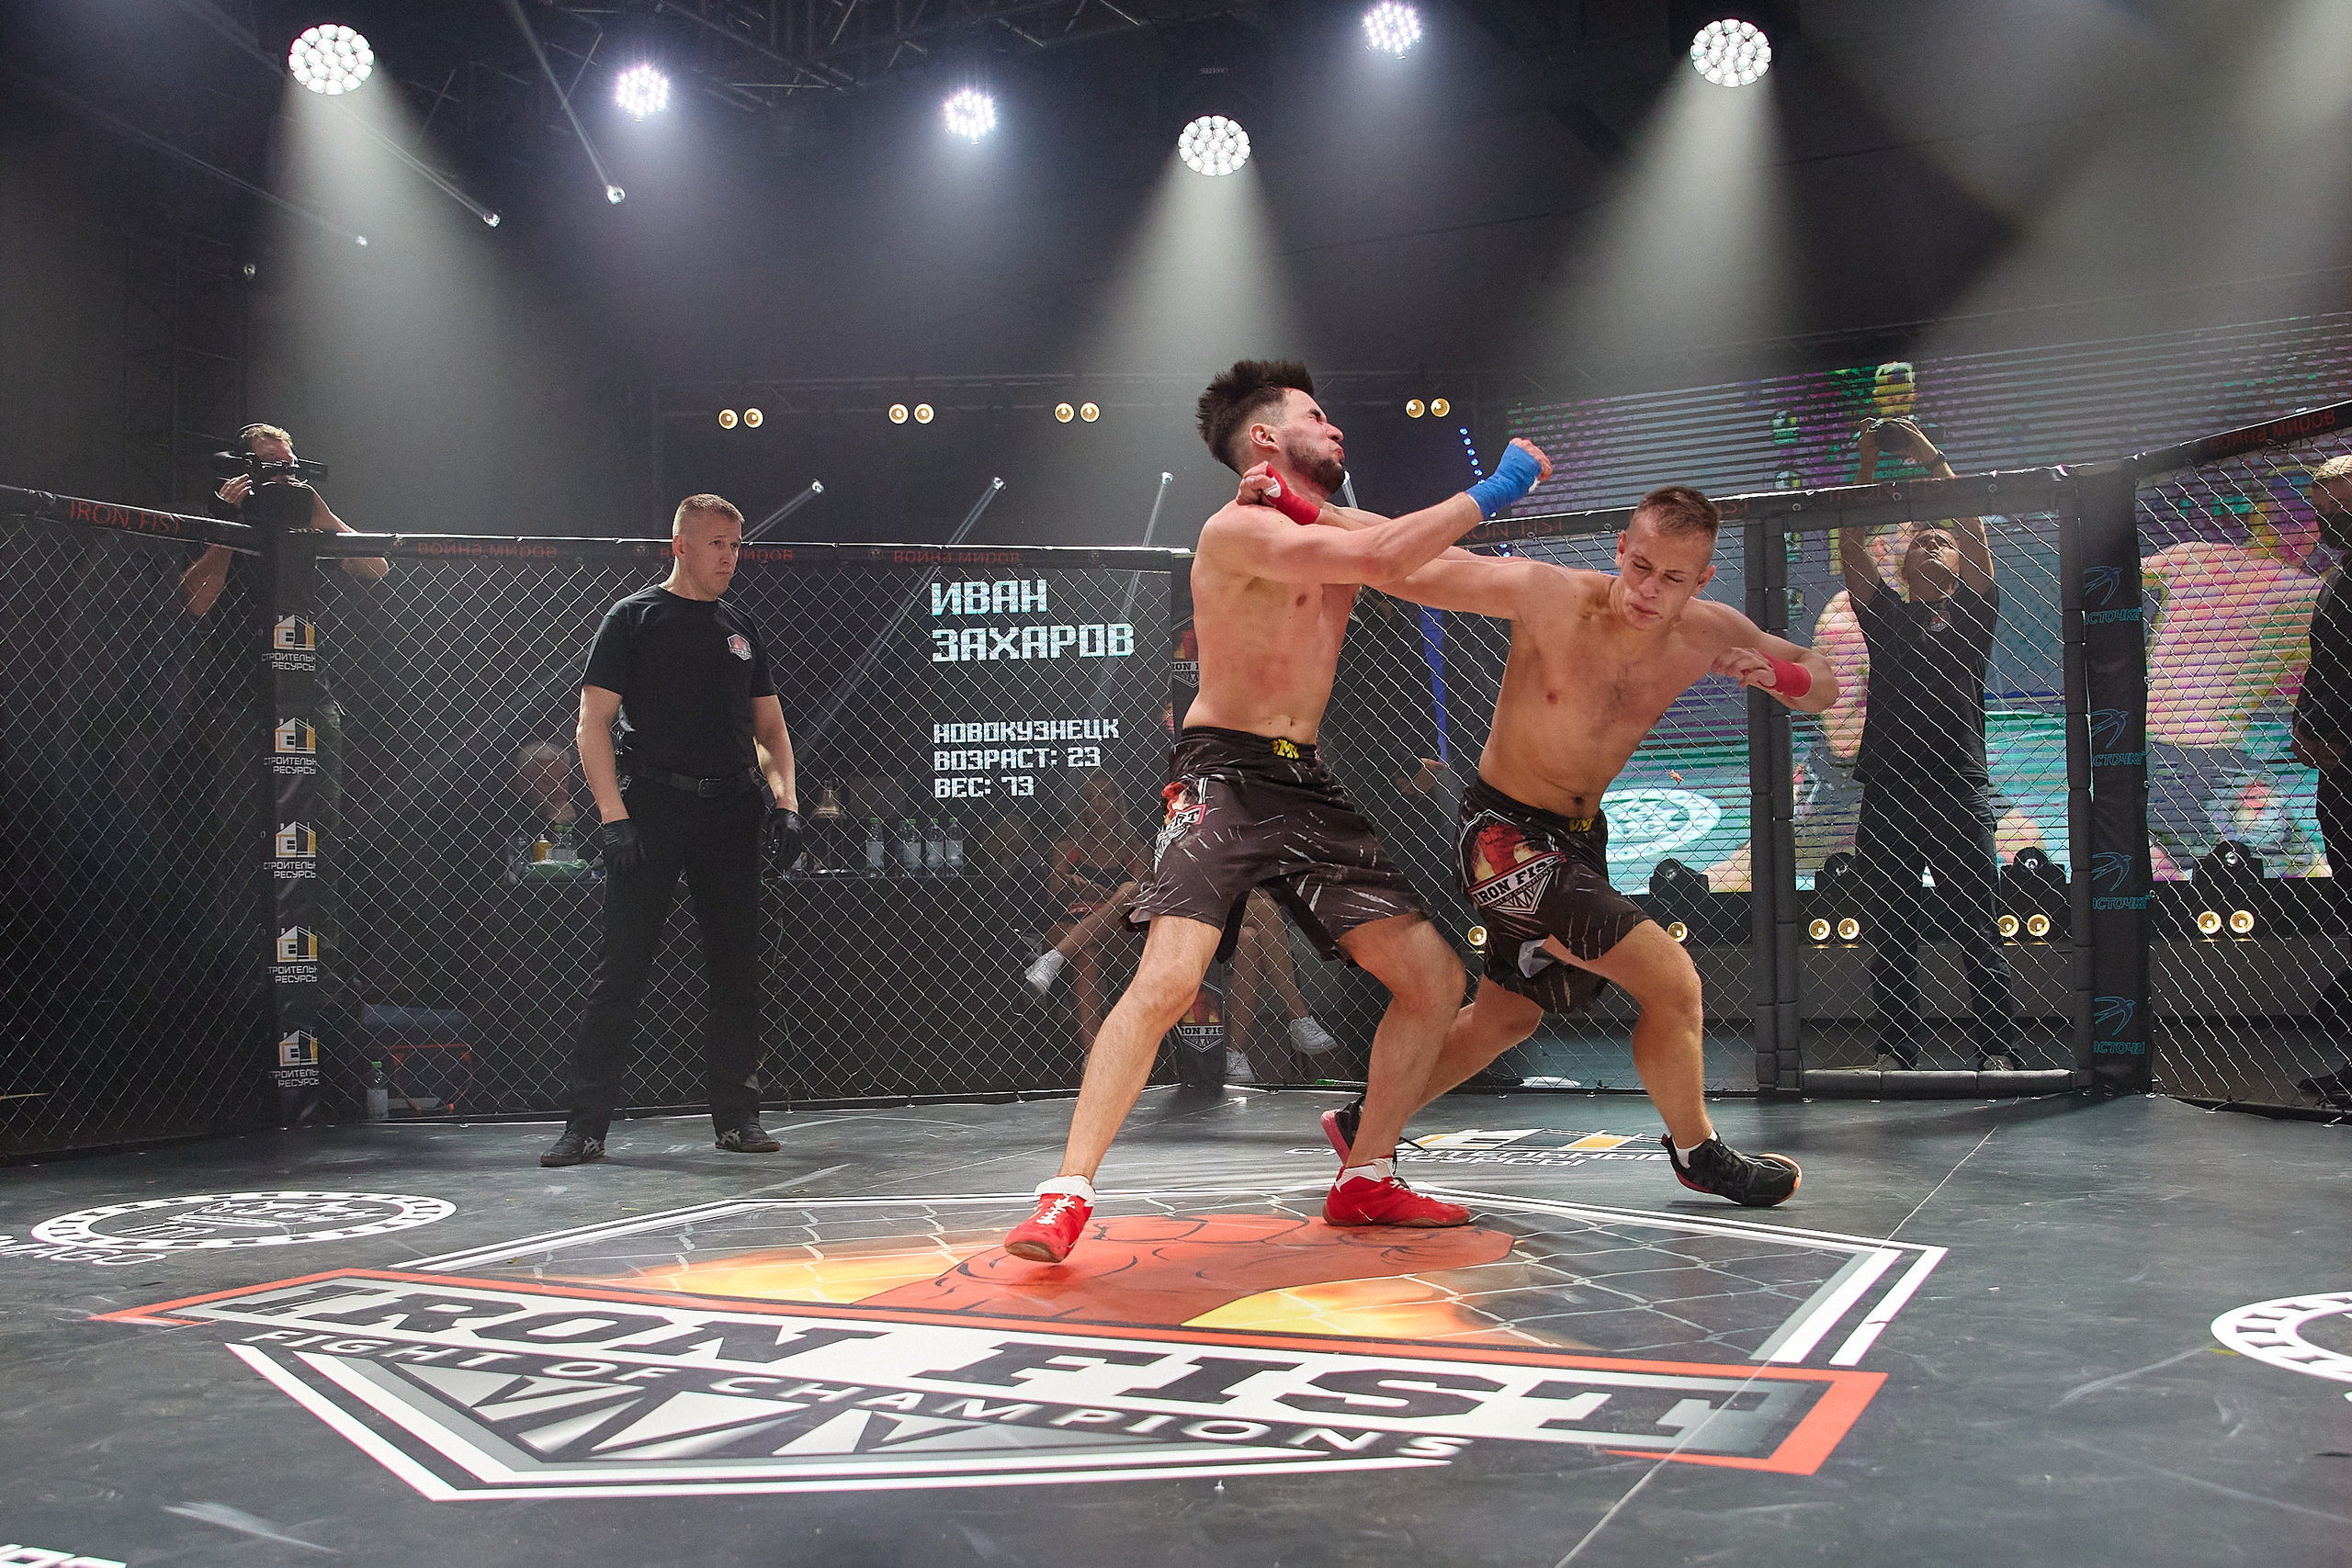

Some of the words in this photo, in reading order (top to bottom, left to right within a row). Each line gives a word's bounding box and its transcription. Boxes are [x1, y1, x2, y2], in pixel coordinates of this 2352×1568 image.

[70, 500, 130, 527] IRON
[932, 580, 1047, 615] ИВАН
[933, 624, 1135, 662] ЗАХАРОВ
[933, 719, 1120, 743] НОВОКУЗНЕЦК
[934, 748, 1057, 771] ВОЗРАСТ:
[1068, 747, 1101, 767] 23
[935, 777, 991, 798] ВЕС:
[1001, 775, 1035, 796] 73
[1474, 878, 1511, 905] IRON
[208, 1284, 895, 1363] IRON
[910, 1341, 1771, 1438] FIST
[242, 1331, 525, 1368] FIGHT
[541, 1359, 684, 1382] OF
[708, 1377, 1475, 1459] CHAMPIONS
